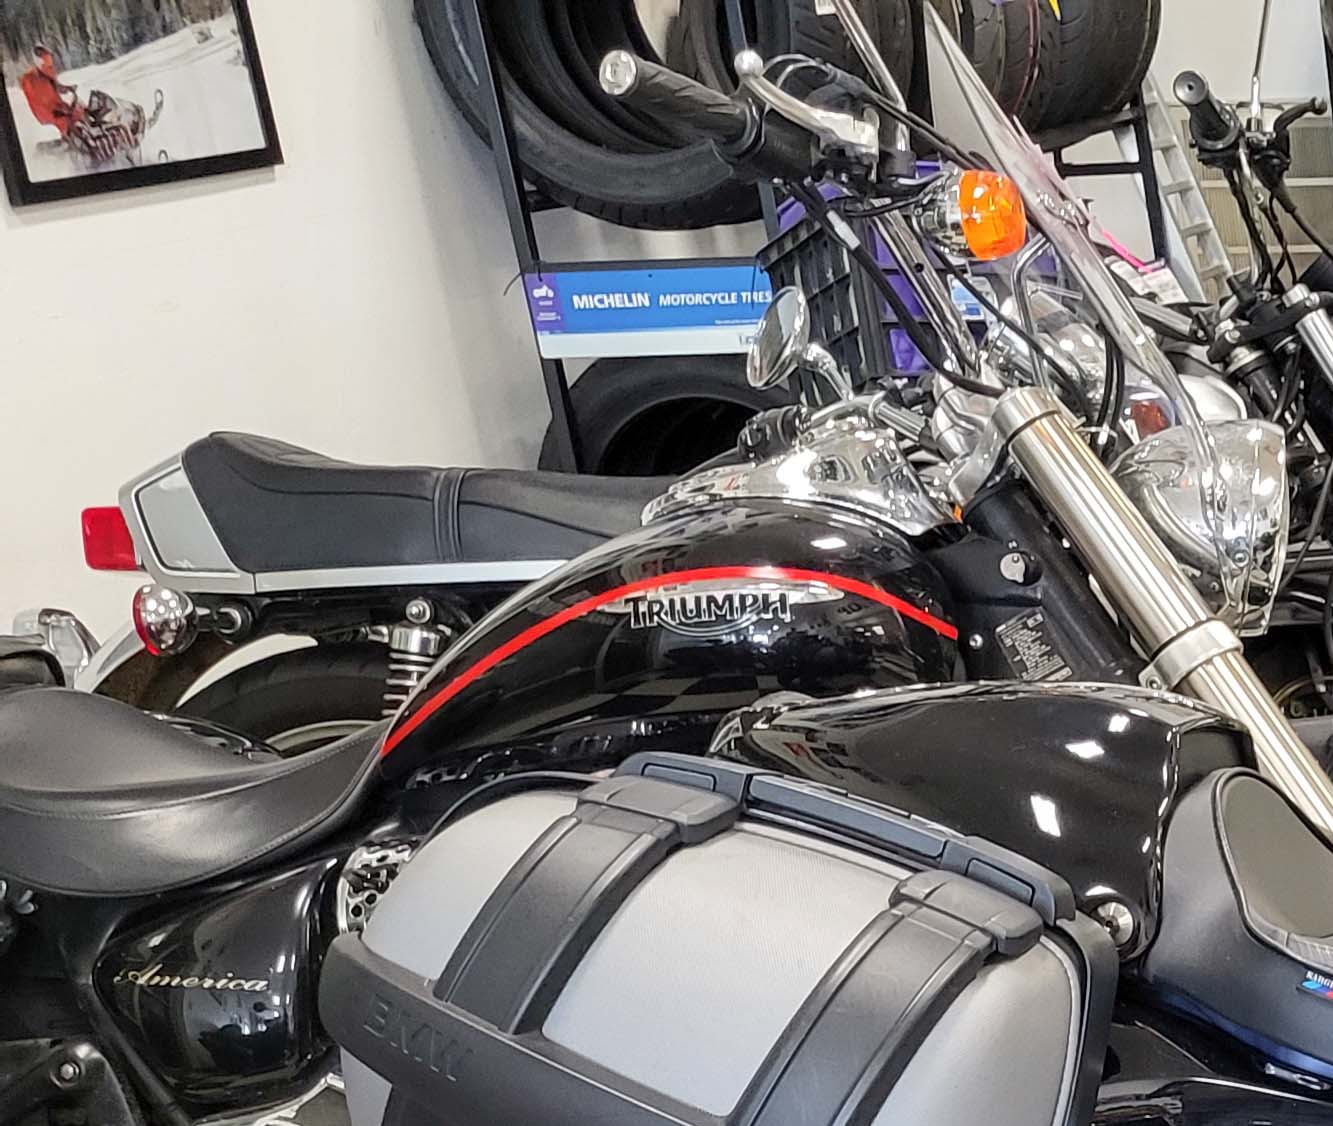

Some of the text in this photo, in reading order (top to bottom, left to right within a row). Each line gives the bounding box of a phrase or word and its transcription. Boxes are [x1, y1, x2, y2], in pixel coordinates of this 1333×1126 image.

[572, 290, 772, 309] MICHELIN MOTORCYCLE TIRES
[624, 592, 792, 629] TRIUMPH
[113, 963, 269, 991] America
